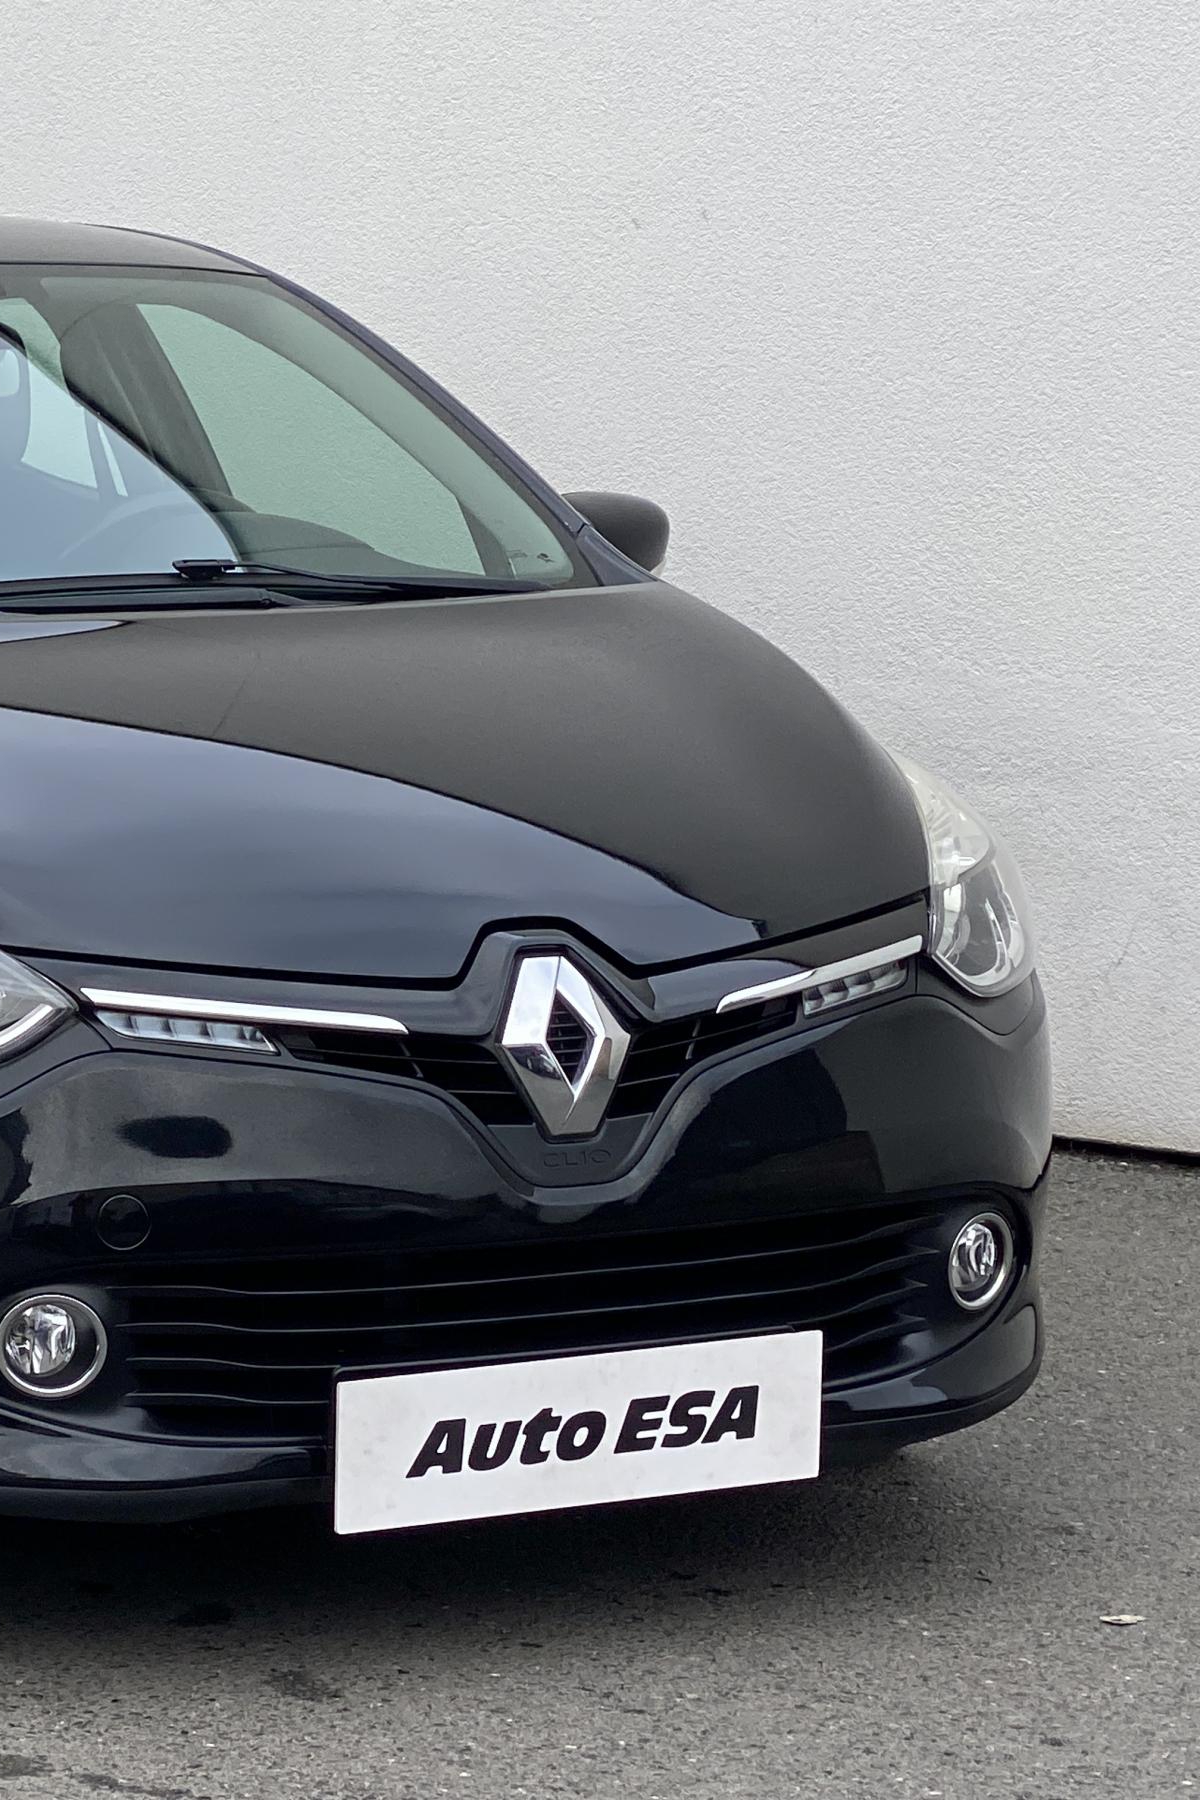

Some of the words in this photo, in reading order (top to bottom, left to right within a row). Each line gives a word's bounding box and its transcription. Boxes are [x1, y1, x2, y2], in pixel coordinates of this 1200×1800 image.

[543, 1149, 612, 1168] CLIO
[405, 1407, 606, 1478] Auto
[613, 1385, 760, 1454] ESA
